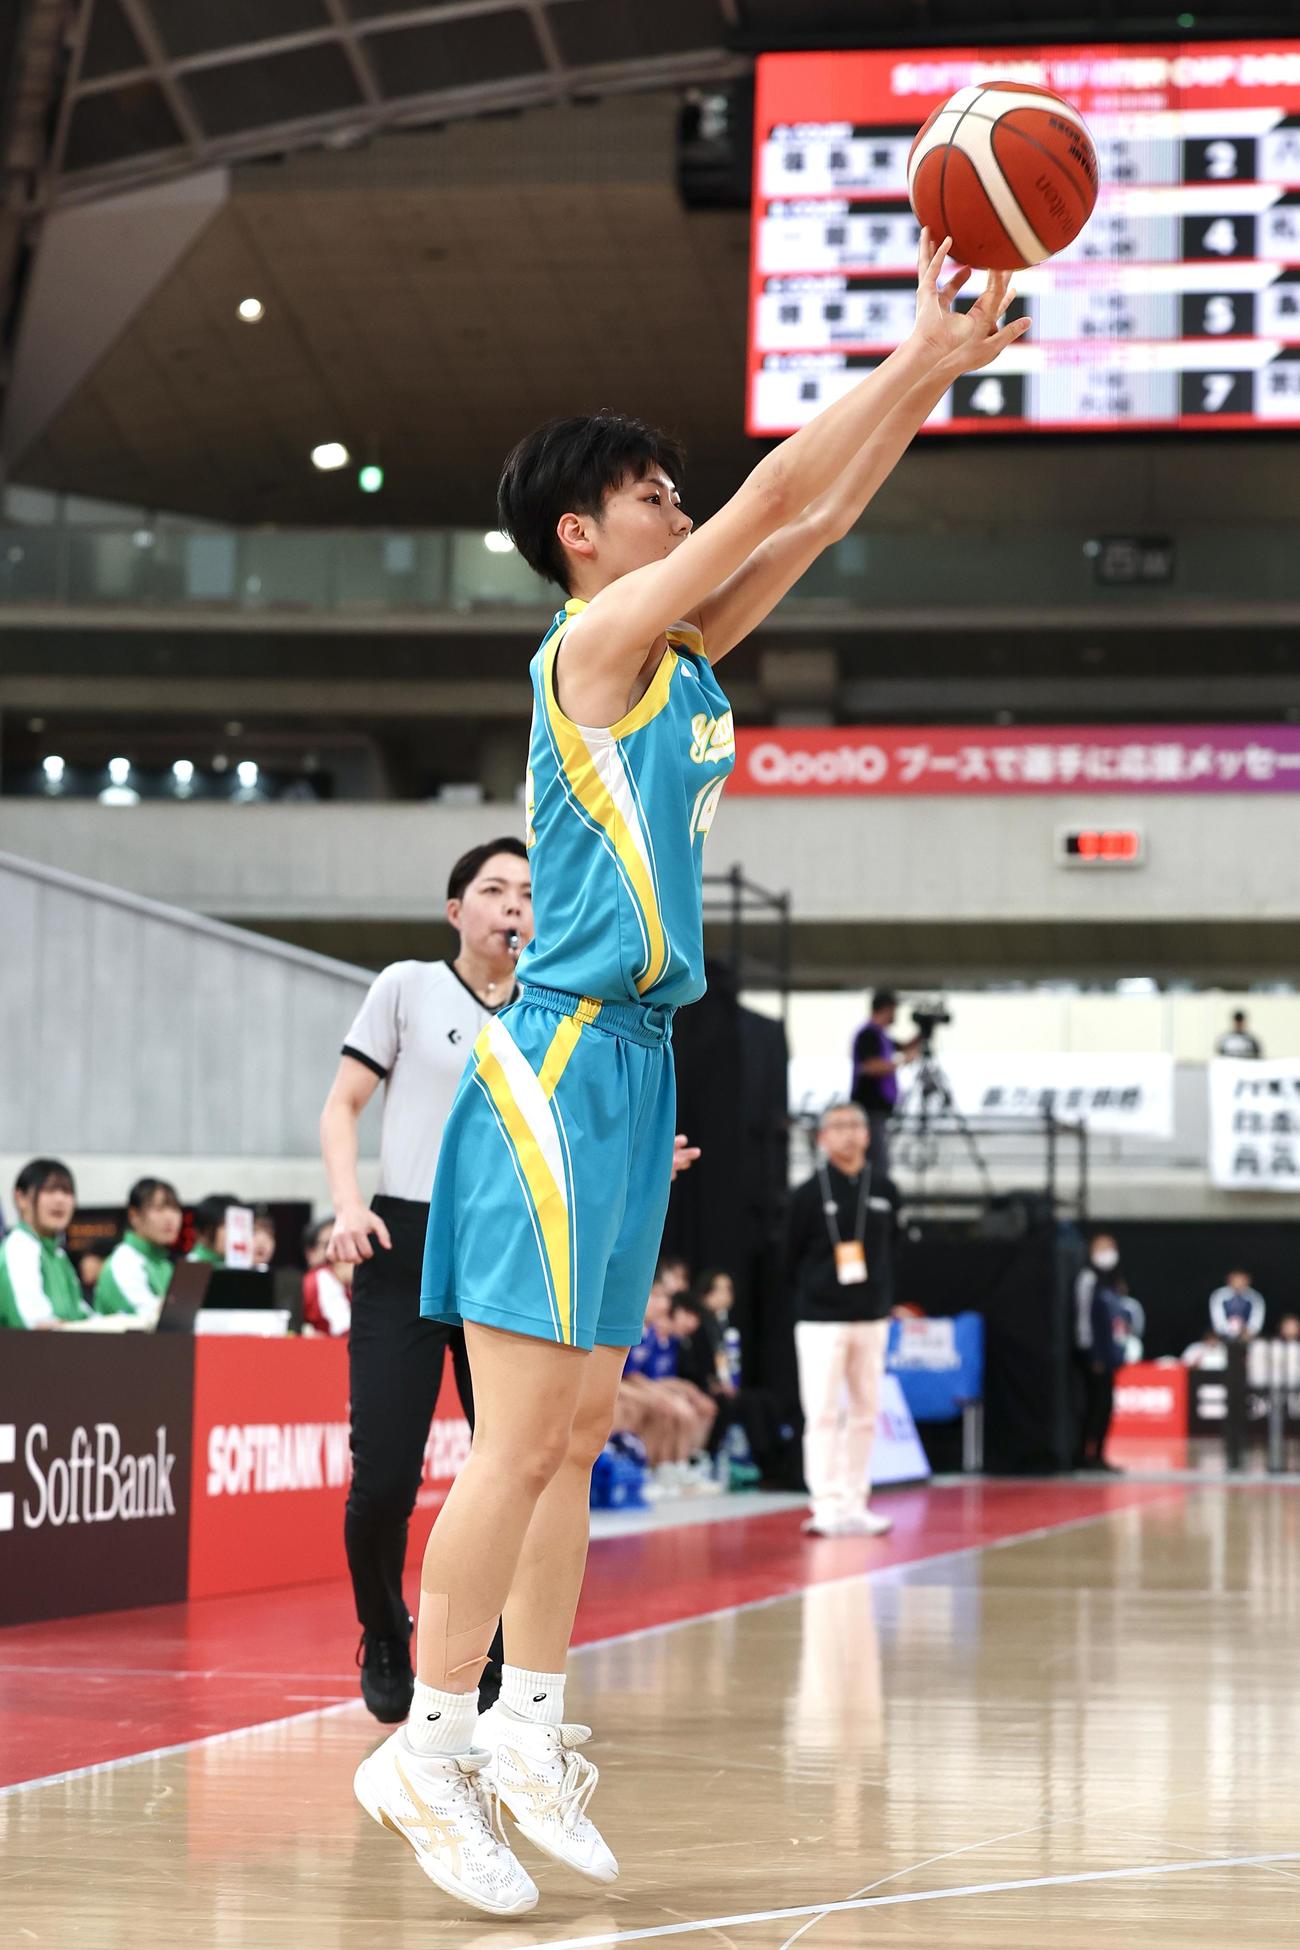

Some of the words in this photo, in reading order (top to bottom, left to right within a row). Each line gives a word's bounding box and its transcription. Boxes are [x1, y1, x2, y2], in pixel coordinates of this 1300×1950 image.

[1203, 217, 1238, 256] 4
[969, 377, 1006, 417] 4
[1202, 372, 1236, 413] 7
[22, 1422, 177, 1529] SoftBank
[206, 1422, 325, 1497] SOFTBANK
